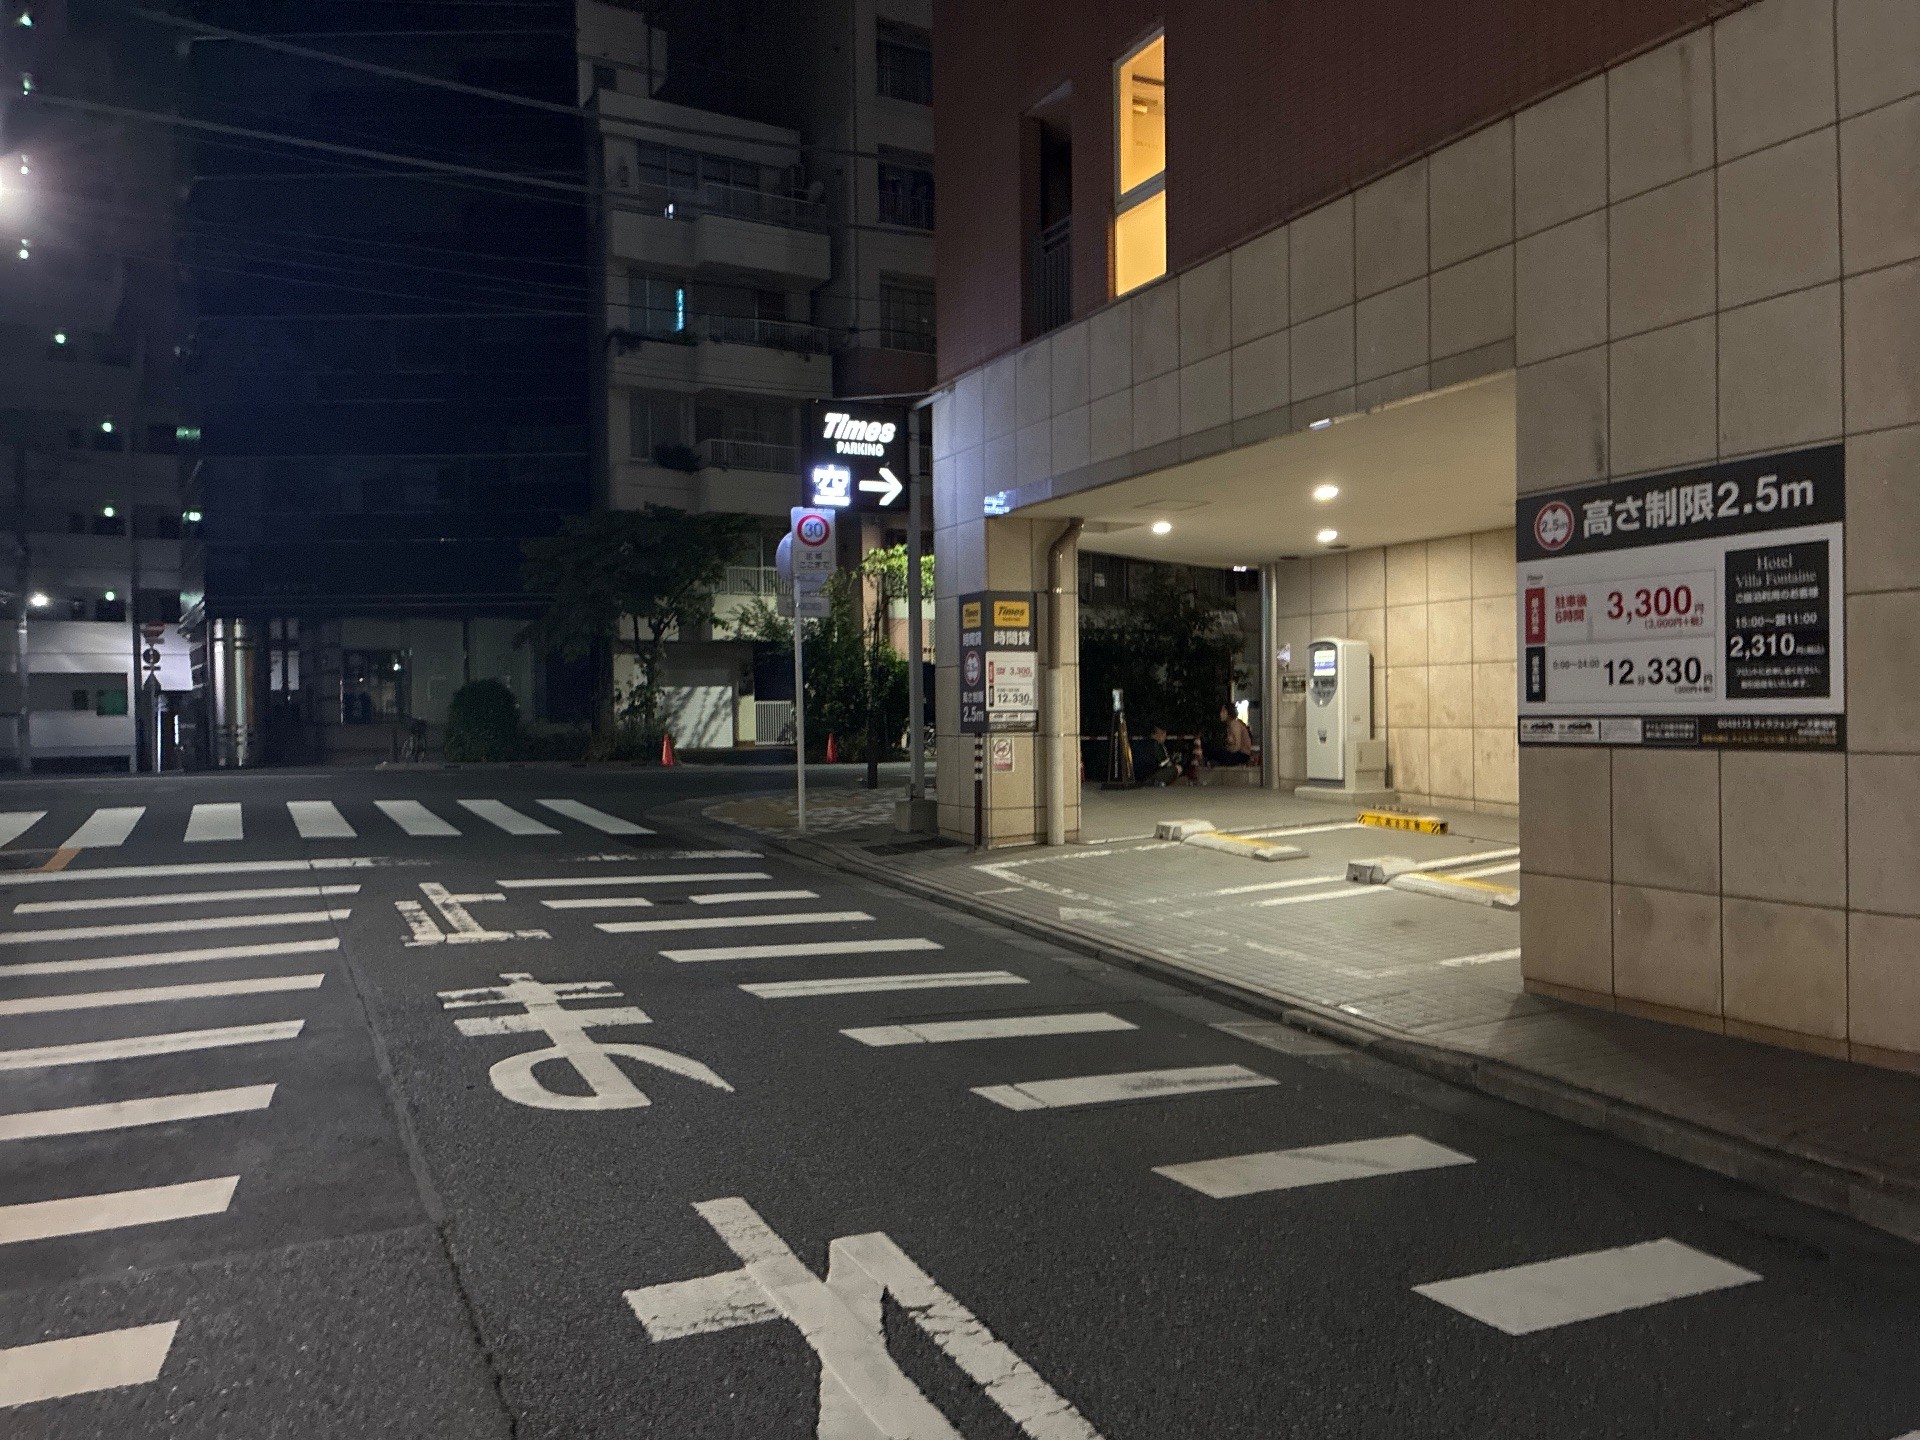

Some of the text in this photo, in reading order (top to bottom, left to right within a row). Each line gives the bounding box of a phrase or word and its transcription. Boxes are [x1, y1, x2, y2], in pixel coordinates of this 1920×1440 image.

[823, 412, 897, 443] Times
[836, 441, 885, 457] PARKING
[1582, 474, 1814, 539] 高さ制限2.5m
[804, 523, 823, 540] 30
[998, 606, 1025, 617] Times
[993, 629, 1031, 646] 時間貸
[963, 706, 985, 723] 2.5m
